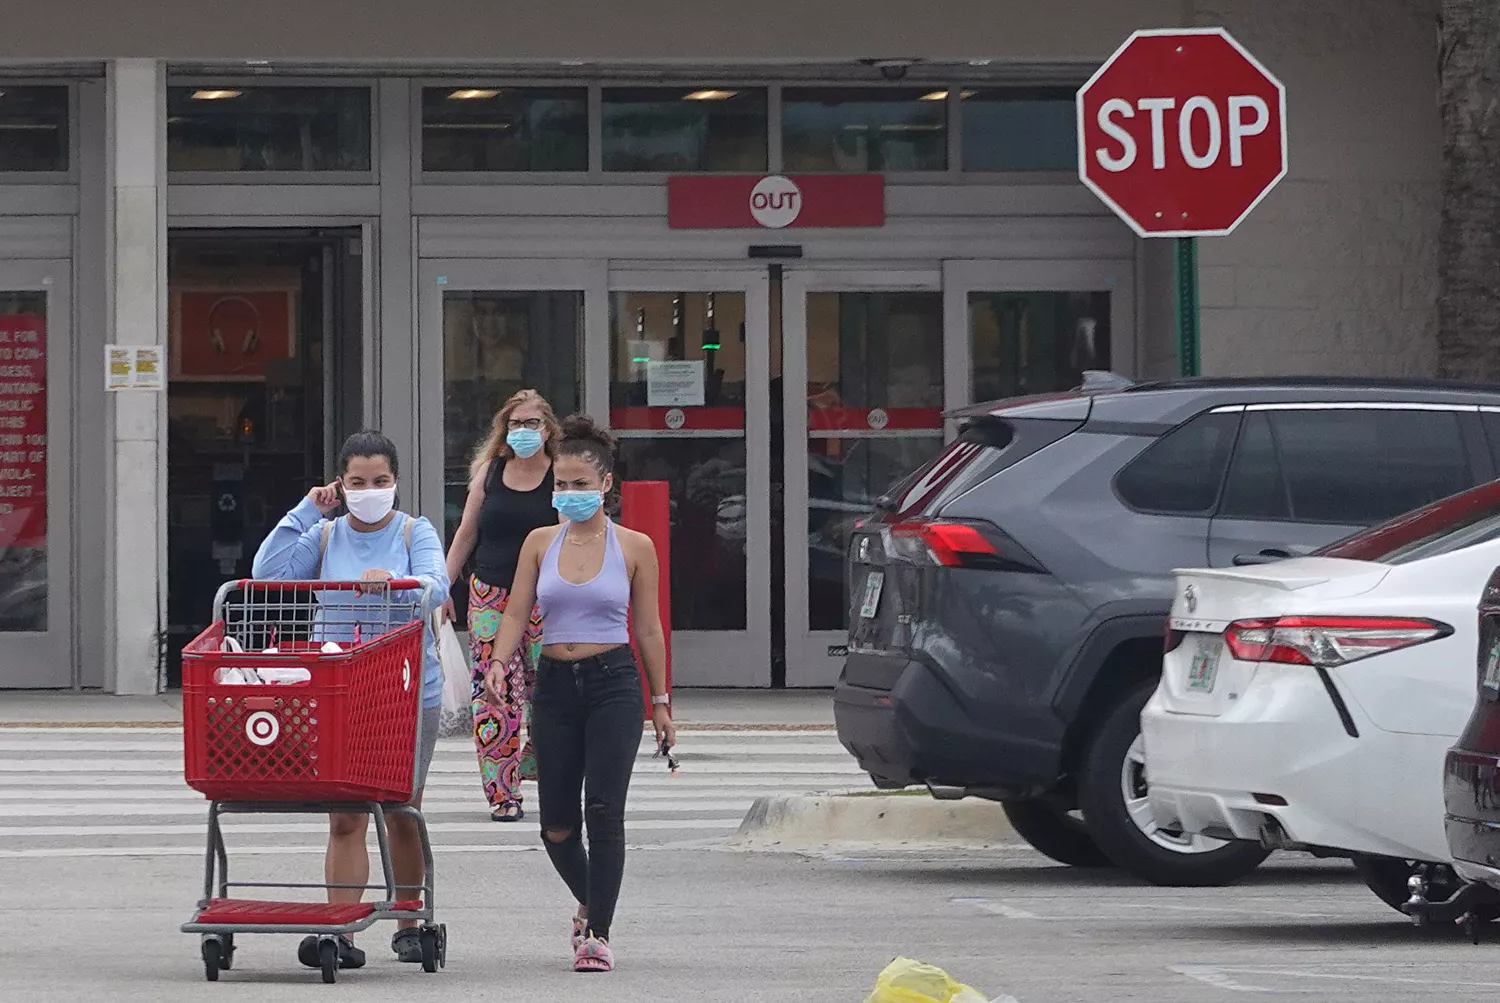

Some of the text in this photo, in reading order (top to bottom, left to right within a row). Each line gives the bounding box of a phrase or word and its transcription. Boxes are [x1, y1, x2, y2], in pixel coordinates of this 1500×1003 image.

[1095, 95, 1270, 172] STOP
[752, 192, 798, 210] OUT
[13, 330, 38, 342] FOR
[0, 416, 26, 428] THIS
[28, 450, 45, 462] OF
